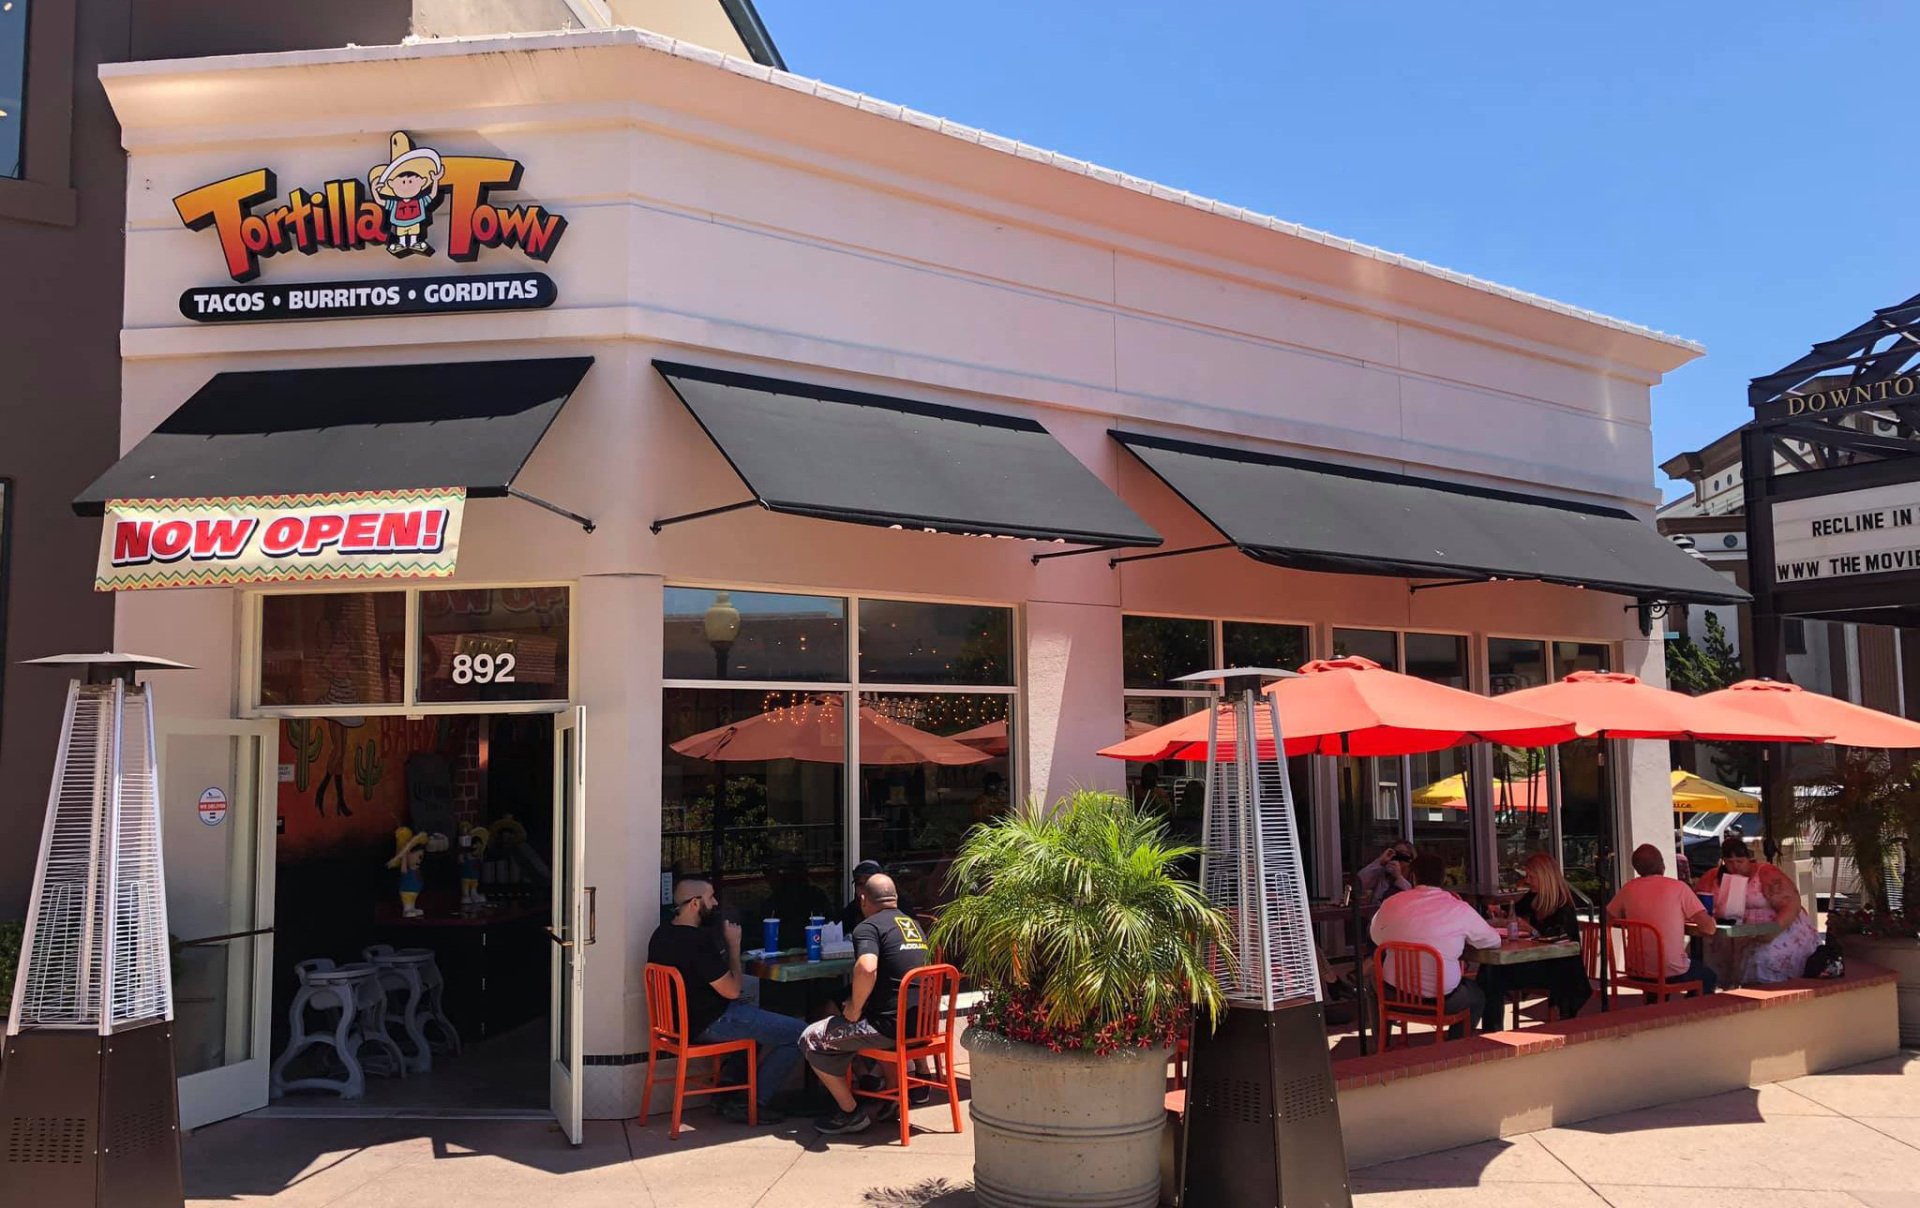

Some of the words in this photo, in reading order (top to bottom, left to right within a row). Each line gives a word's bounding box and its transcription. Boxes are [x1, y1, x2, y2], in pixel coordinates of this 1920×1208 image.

[172, 167, 388, 284] Tortilla
[193, 293, 265, 313] TACOS
[288, 286, 400, 309] BURRITOS
[424, 279, 538, 303] GORDITAS
[111, 517, 259, 567] NOW
[260, 508, 450, 558] OPEN!
[1812, 512, 1884, 537] RECLINE
[1893, 508, 1912, 526] IN
[1777, 561, 1819, 580] WWW
[452, 653, 516, 685] 892
